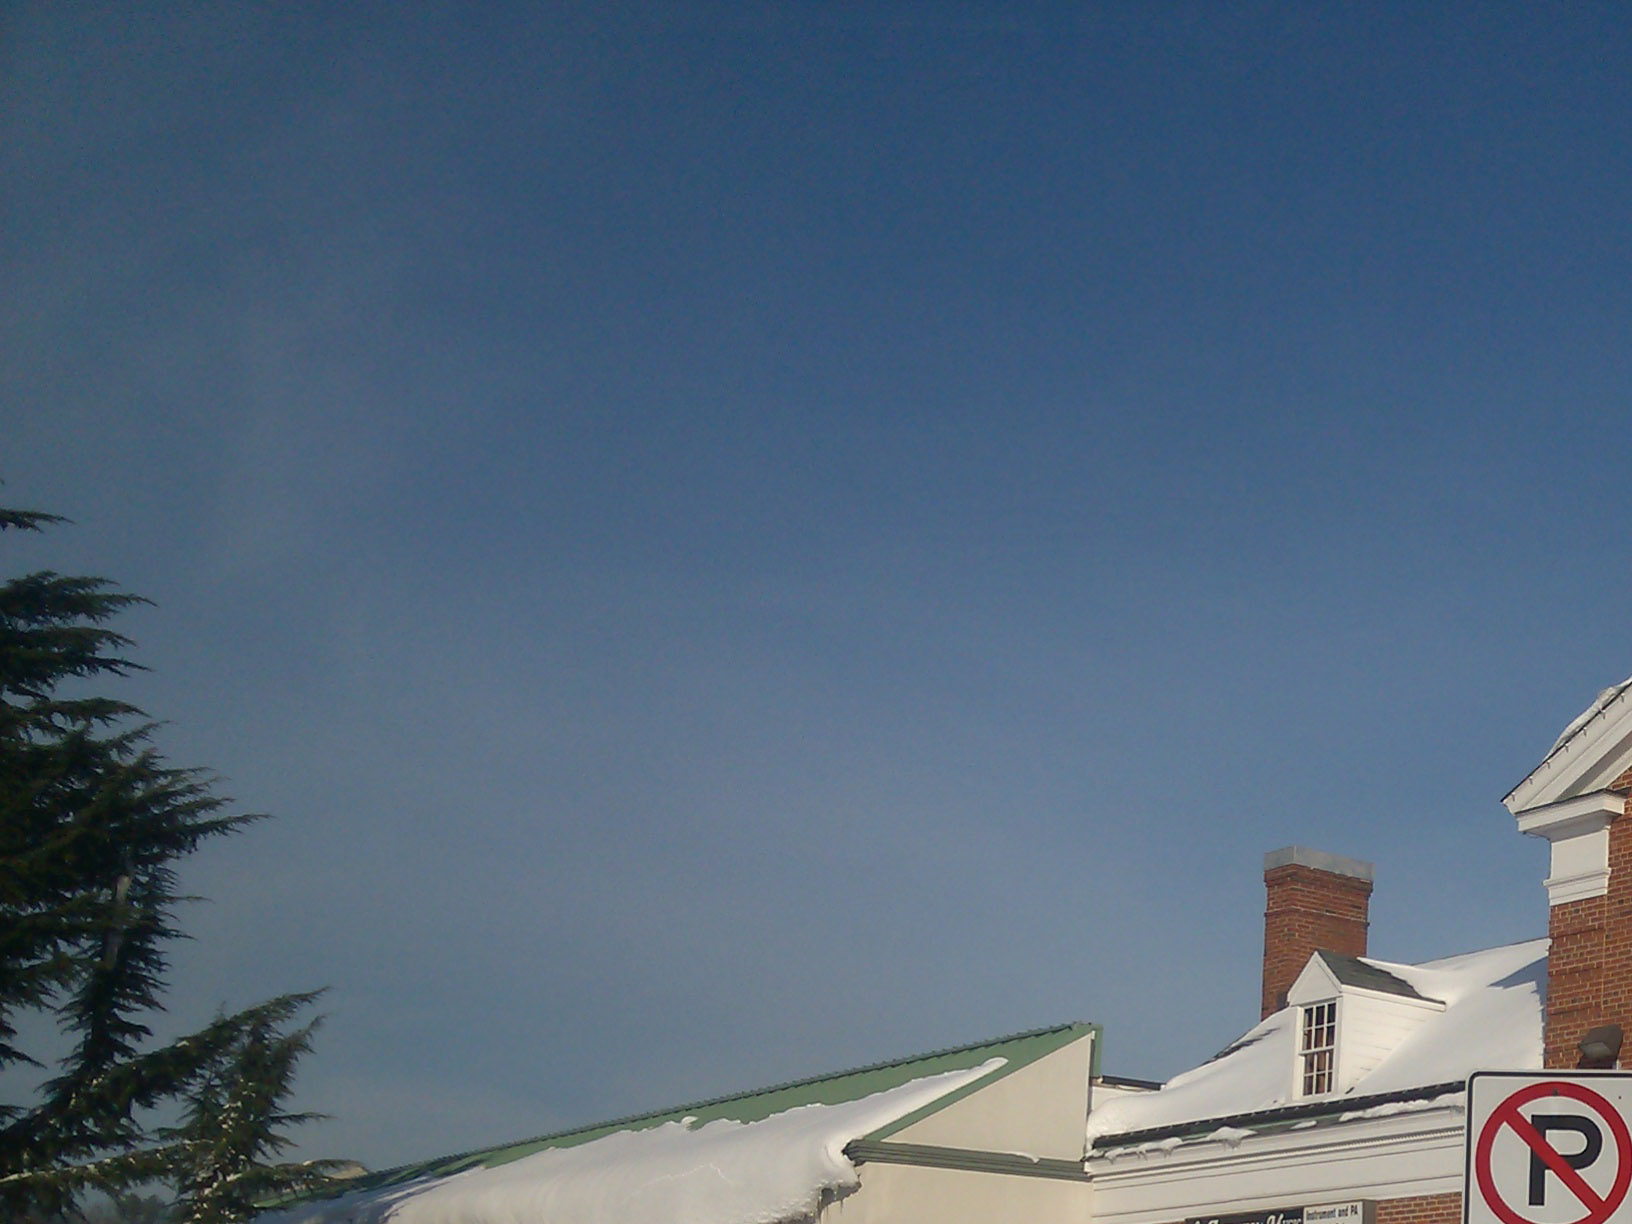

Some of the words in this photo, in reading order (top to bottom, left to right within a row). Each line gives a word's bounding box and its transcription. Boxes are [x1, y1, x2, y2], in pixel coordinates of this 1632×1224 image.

[1306, 1208, 1336, 1220] Instrument
[1338, 1205, 1348, 1217] and
[1350, 1204, 1358, 1216] PA
